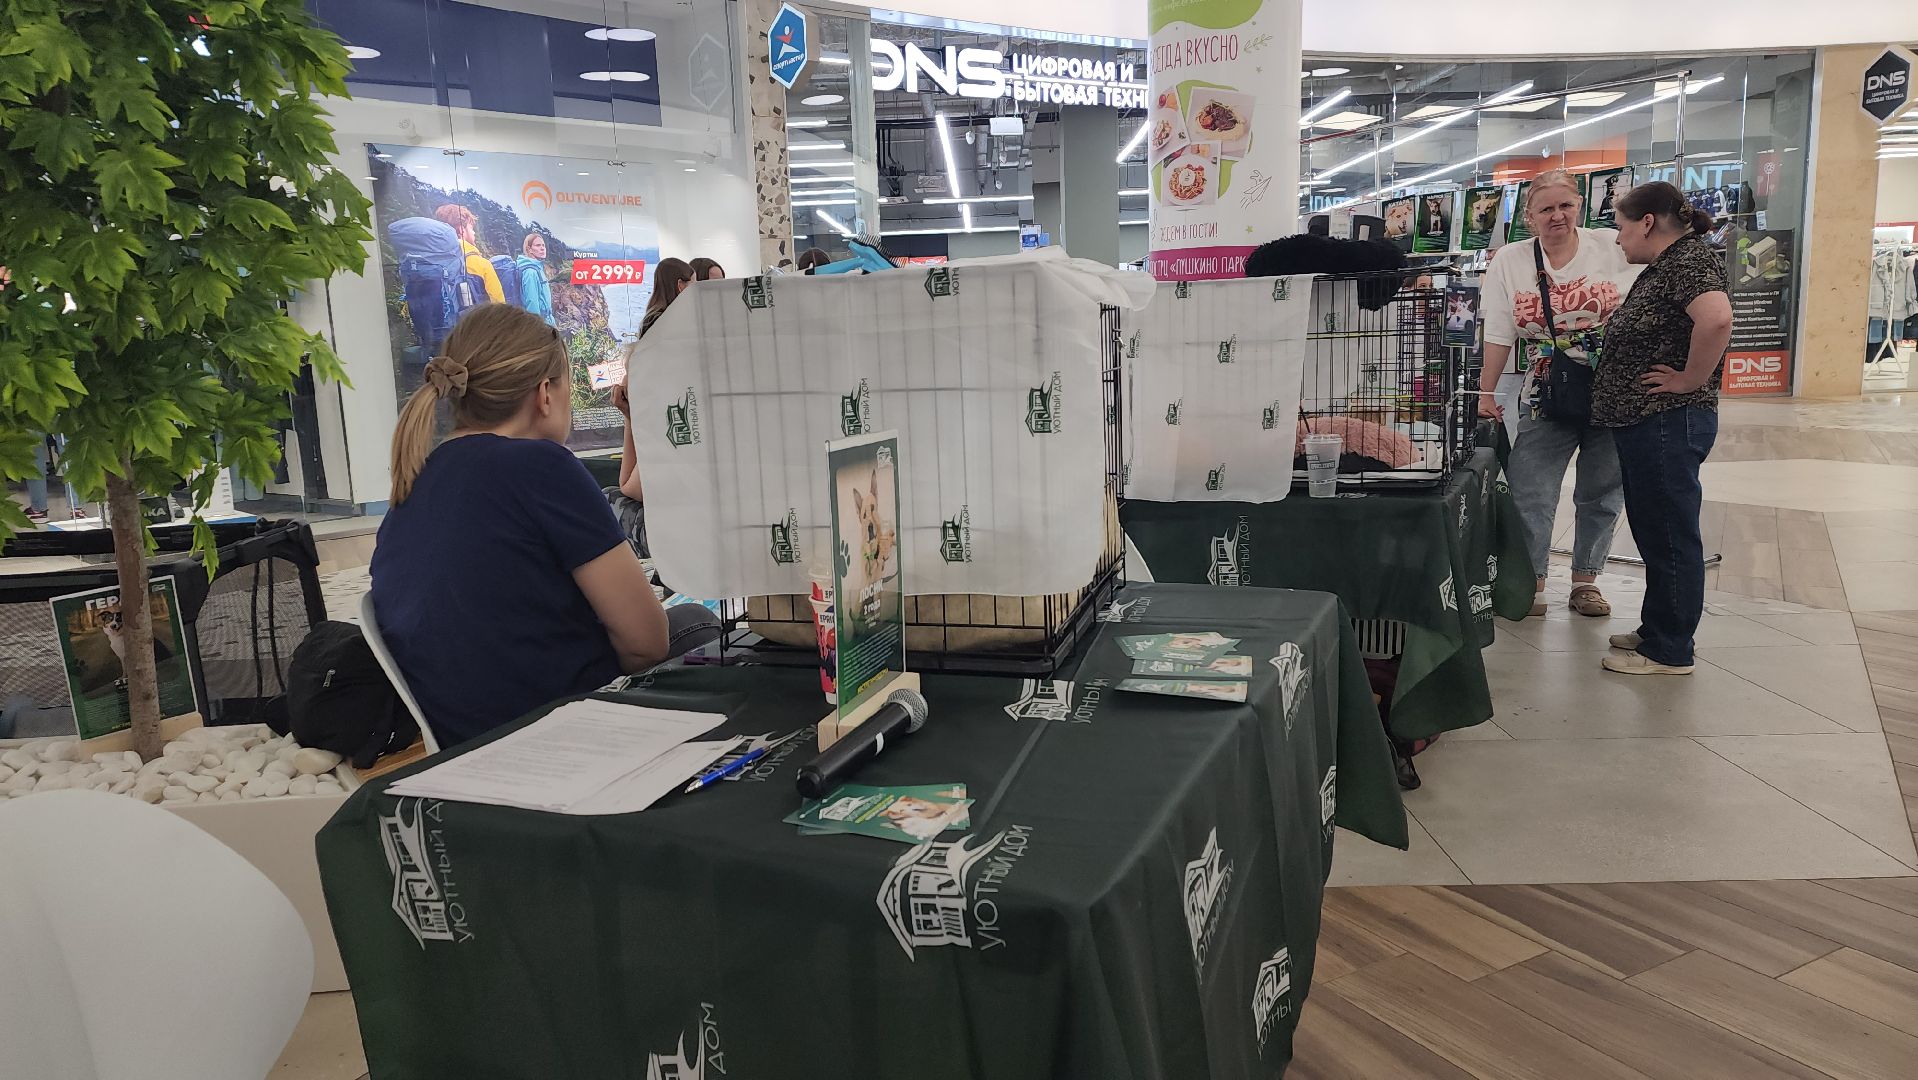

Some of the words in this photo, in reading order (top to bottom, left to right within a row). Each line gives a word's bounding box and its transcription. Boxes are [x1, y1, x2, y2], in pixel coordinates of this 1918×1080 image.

[1186, 34, 1238, 66] ВКУСНО
[871, 38, 1005, 98] DNS
[1013, 53, 1115, 80] ЦИФРОВАЯ
[1120, 62, 1134, 83] И
[1867, 70, 1906, 90] DNS
[1013, 83, 1098, 106] БЫТОВАЯ
[555, 191, 643, 206] OUTVENTURE
[1190, 221, 1218, 240] ГОСТИ!
[573, 250, 598, 259] Куртки
[764, 276, 775, 309] УЮТНЫ
[1729, 357, 1782, 374] DNS
[860, 377, 871, 402] ДОМ
[1052, 370, 1063, 393] ДОМ
[688, 386, 699, 408] ДОМ
[861, 402, 872, 434] ЮТНЫЙ
[1052, 395, 1062, 434] УЮТНЫЙ
[961, 504, 971, 526] ДОМ
[1238, 515, 1250, 541] ДОМ
[961, 526, 972, 563] УЮТНЫЙ
[1240, 543, 1252, 586] ЮТНЫЙ
[85, 595, 121, 611] ГЕР
[430, 828, 474, 945] УЮТНЫЙ
[973, 855, 1016, 951] УЮТНЫЙ
[1000, 823, 1034, 858] ДОМ
[701, 1001, 727, 1075] ДОМ
[1256, 999, 1292, 1061] УЮТНЫ
